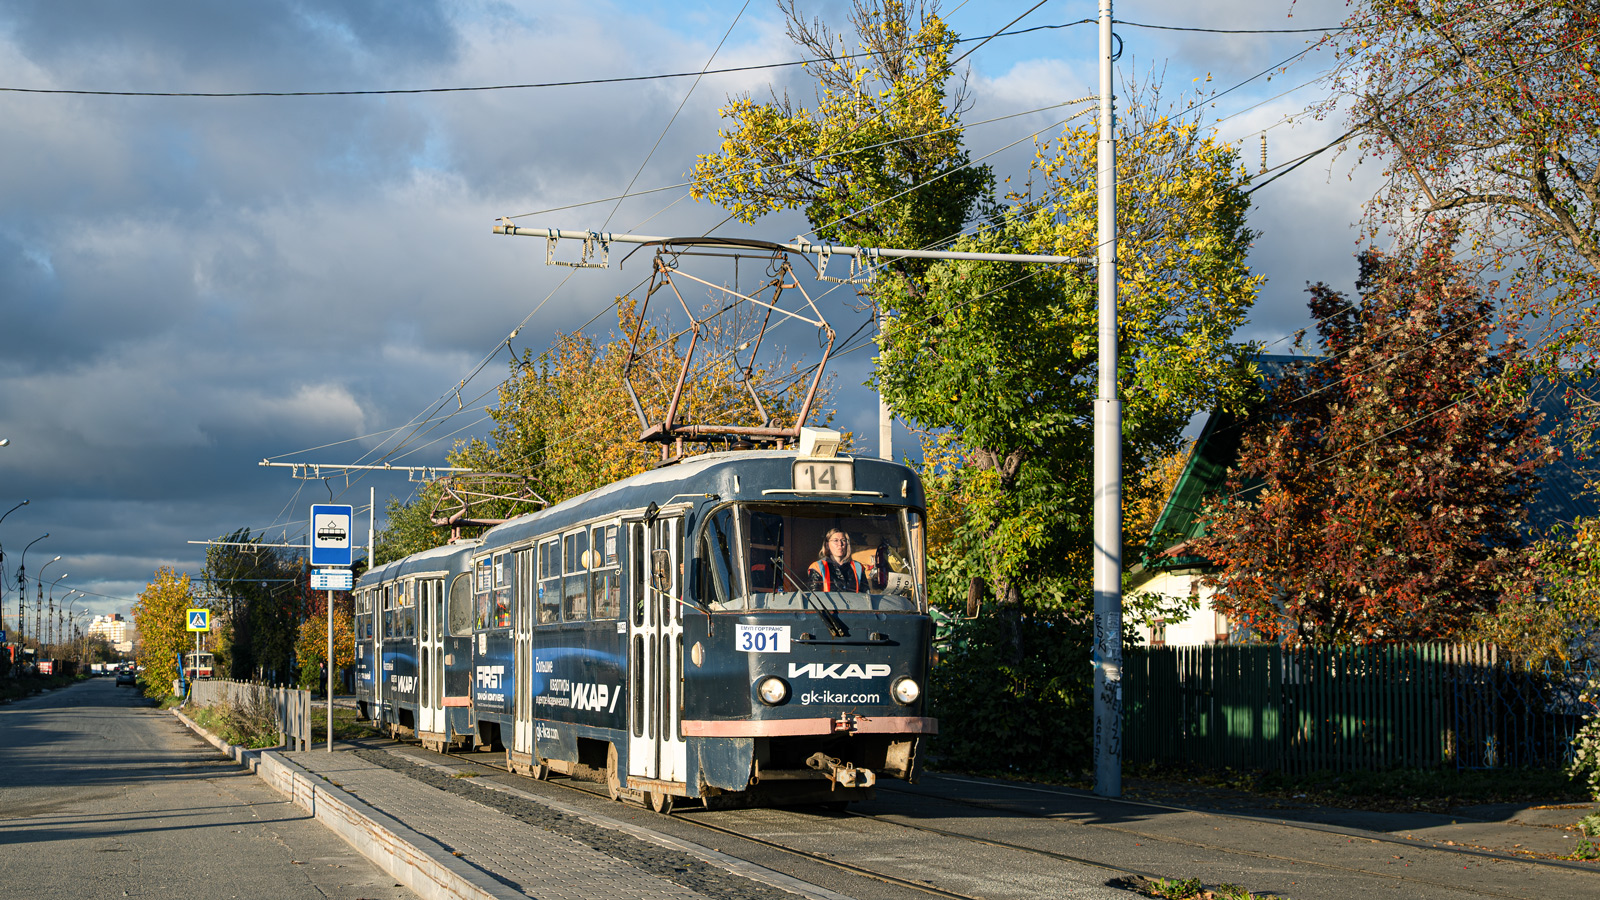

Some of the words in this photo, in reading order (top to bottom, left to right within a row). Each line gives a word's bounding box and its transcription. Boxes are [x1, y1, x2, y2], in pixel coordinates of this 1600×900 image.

[804, 465, 837, 490] 14
[742, 632, 778, 651] 301
[476, 665, 505, 689] FIRST
[787, 662, 892, 680] ИКАР
[800, 690, 880, 706] gk-ikar.com
